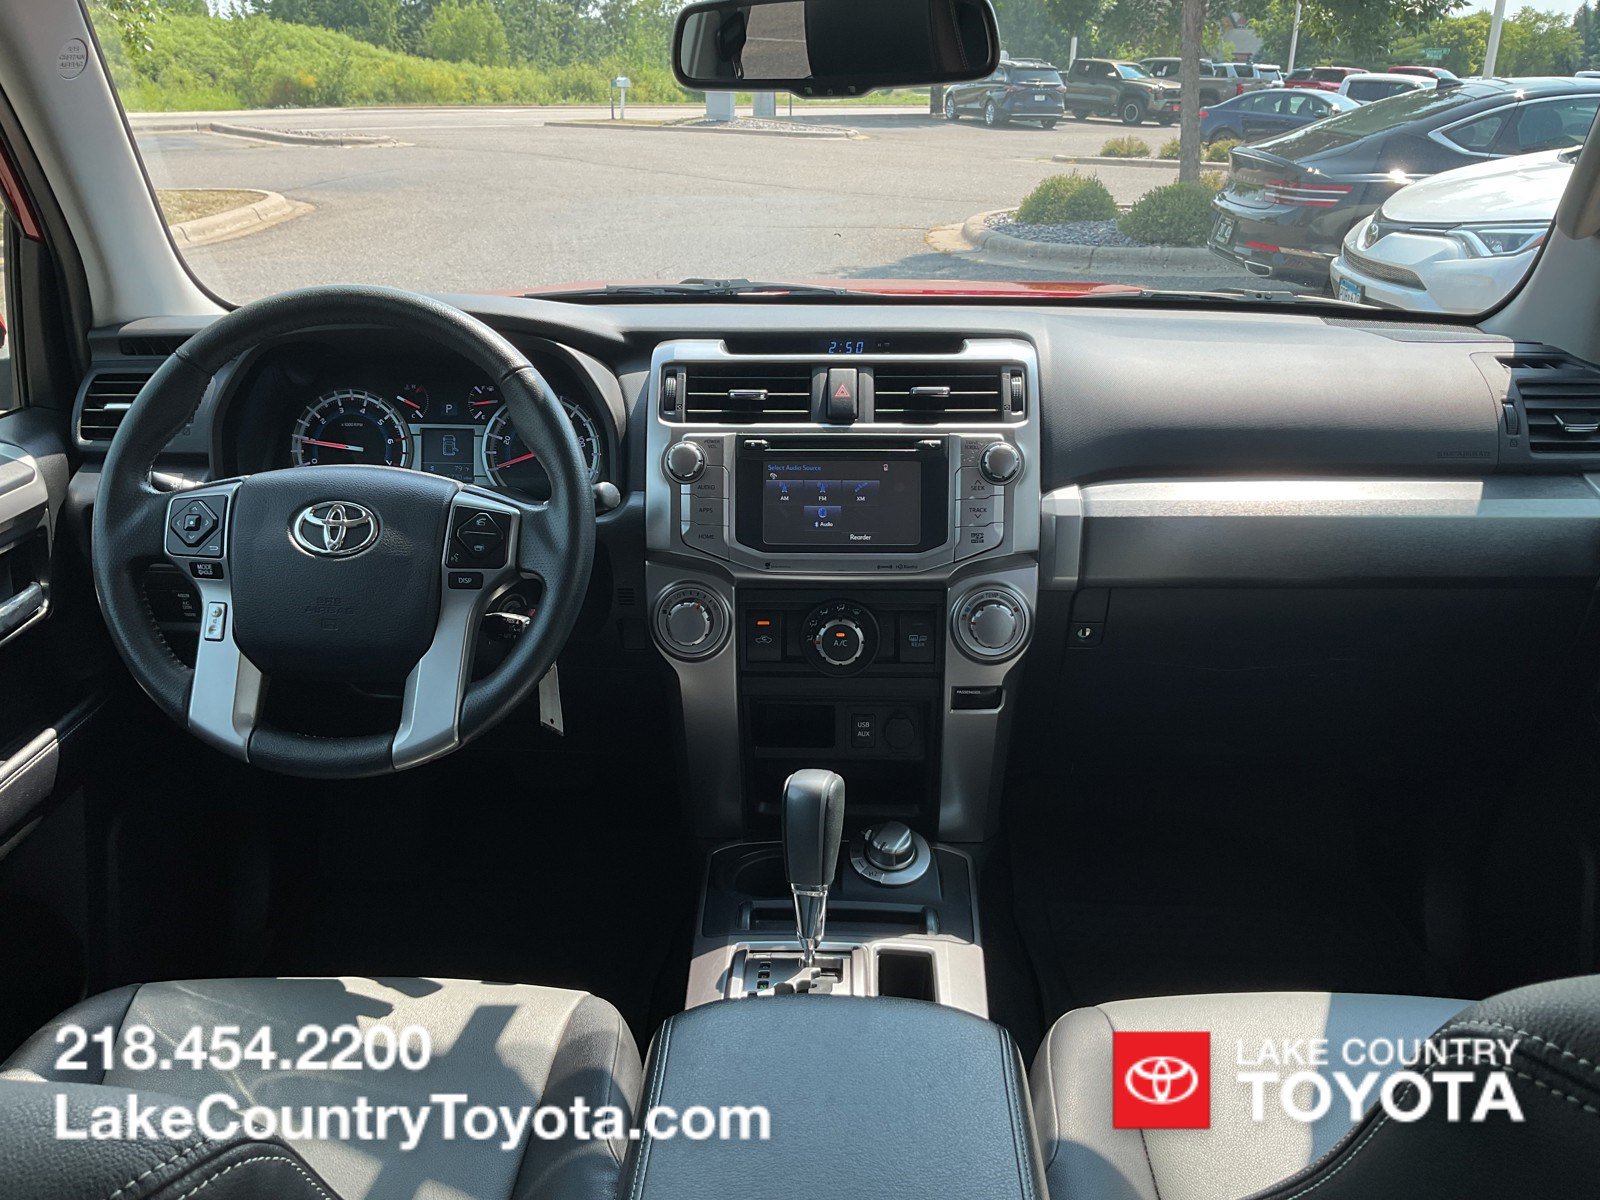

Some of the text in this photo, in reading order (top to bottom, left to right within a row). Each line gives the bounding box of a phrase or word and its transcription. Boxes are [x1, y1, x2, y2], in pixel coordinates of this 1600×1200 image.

[828, 341, 865, 354] 2:50
[445, 404, 453, 414] P
[319, 417, 327, 425] 2
[377, 418, 384, 426] 5
[849, 533, 871, 541] Reorder
